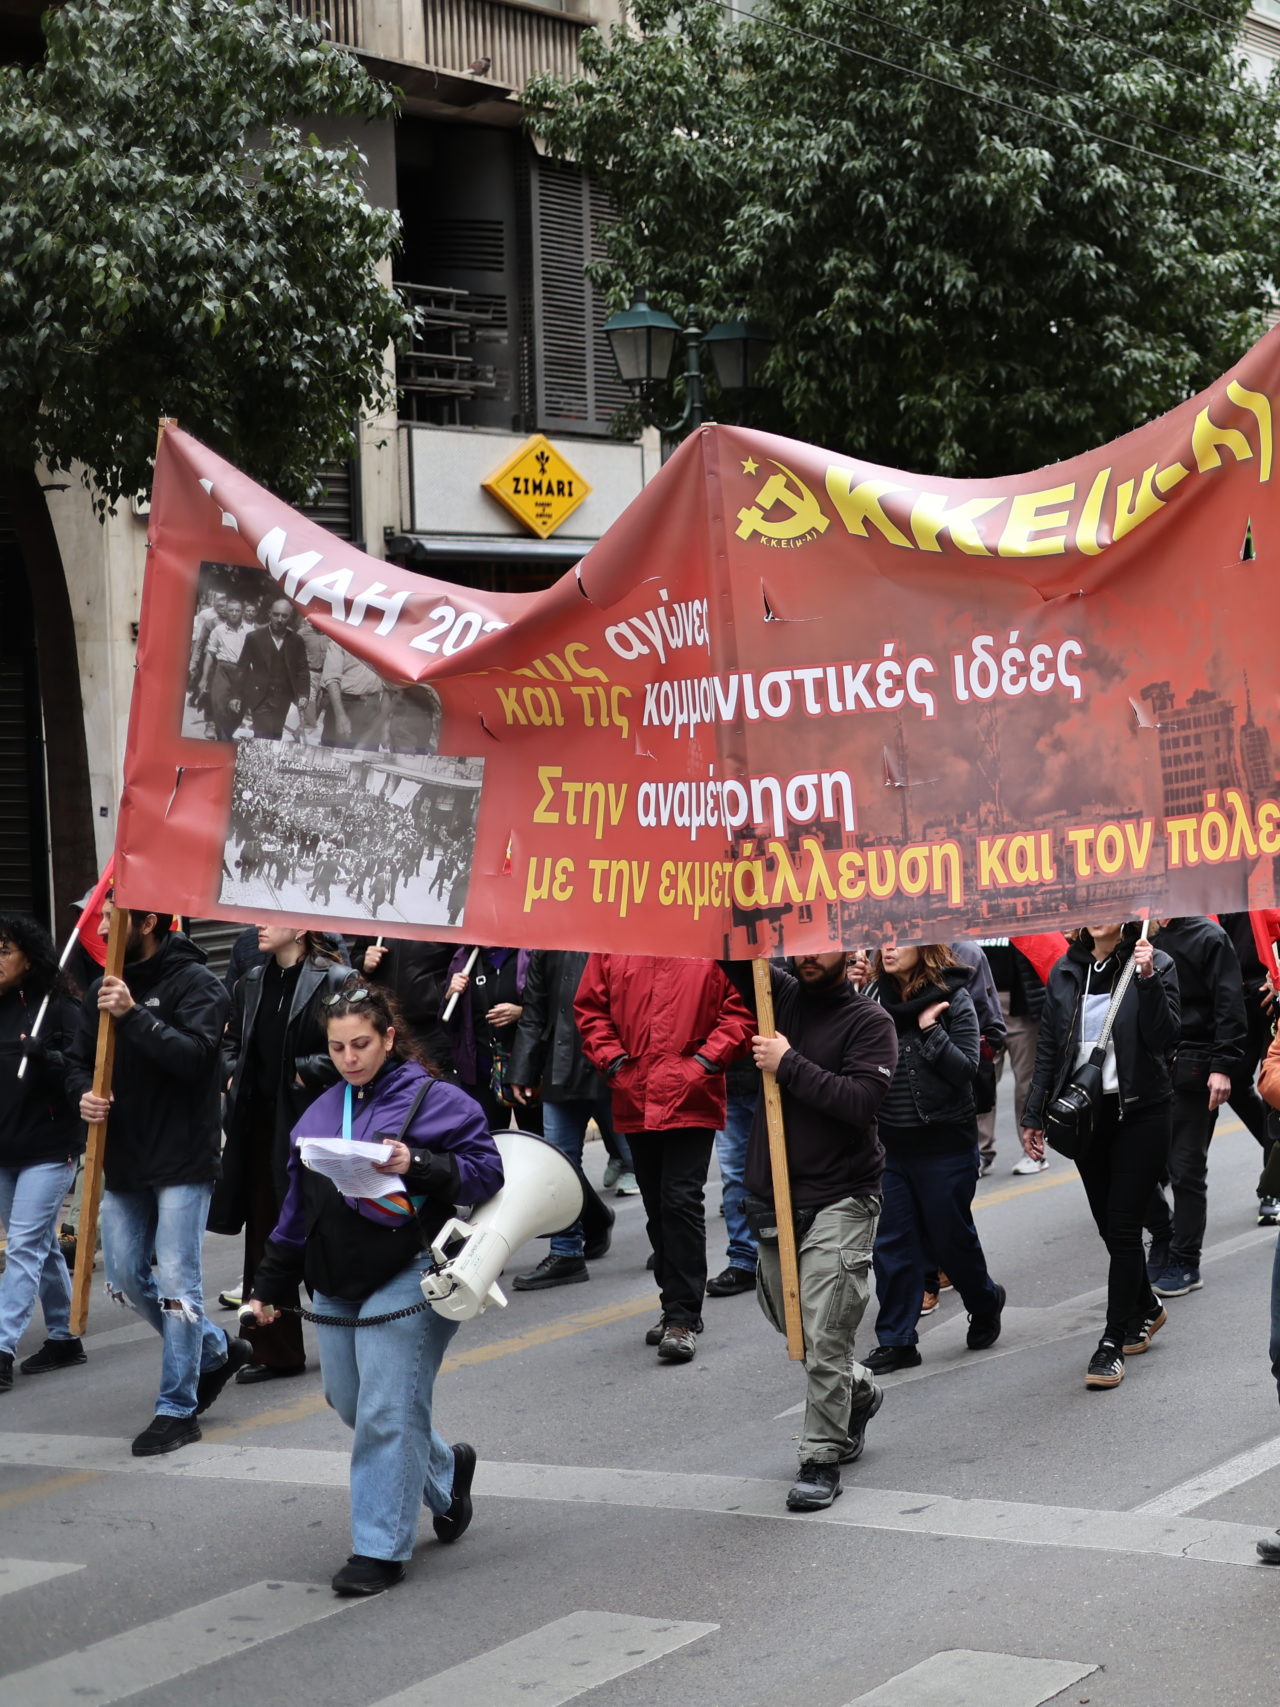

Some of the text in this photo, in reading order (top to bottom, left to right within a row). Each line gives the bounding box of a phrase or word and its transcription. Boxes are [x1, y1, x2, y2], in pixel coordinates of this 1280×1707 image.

[513, 477, 573, 497] ZIMARI
[256, 526, 414, 637] ΜΑΗ
[495, 686, 565, 727] και
[570, 685, 633, 739] τις
[955, 631, 1082, 702] ιδέες
[532, 765, 628, 839] Στην
[523, 854, 575, 913] με
[588, 859, 651, 918] την
[658, 836, 961, 921] εκμετάλλευση
[979, 835, 1053, 887] και
[1068, 820, 1153, 874] τον
